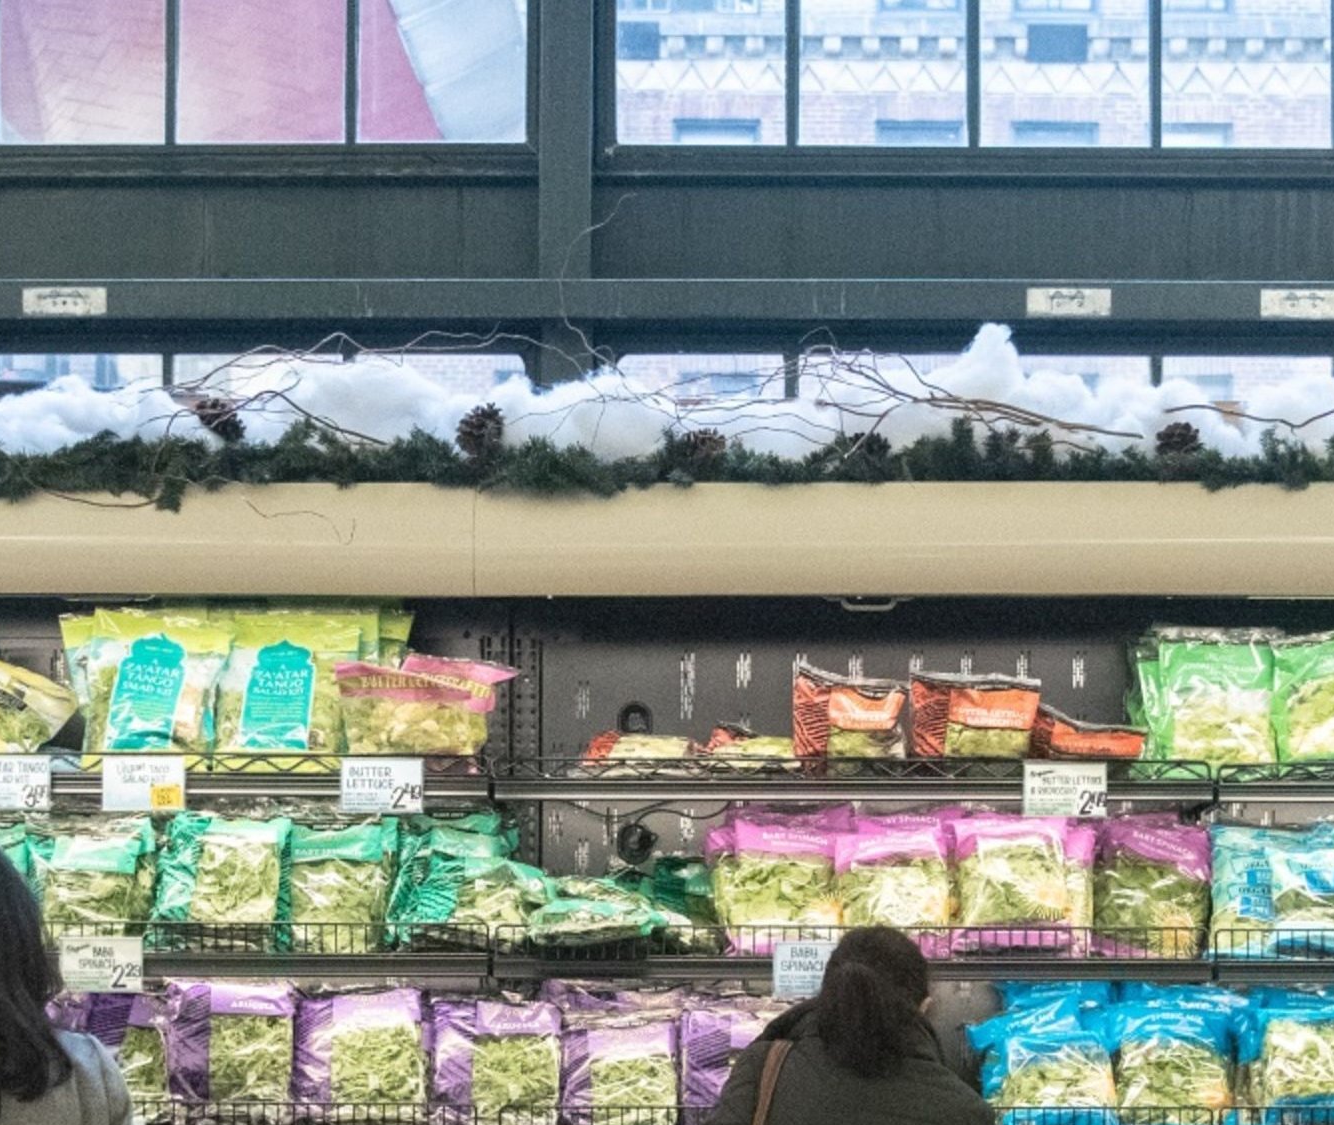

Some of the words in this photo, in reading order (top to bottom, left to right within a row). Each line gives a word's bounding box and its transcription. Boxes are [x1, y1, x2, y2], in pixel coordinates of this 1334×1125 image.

[258, 678, 304, 688] TANGO
[348, 766, 393, 777] BUTTER
[346, 778, 395, 790] LETTUCE
[790, 946, 818, 959] BABY
[78, 958, 116, 970] SPINACH
